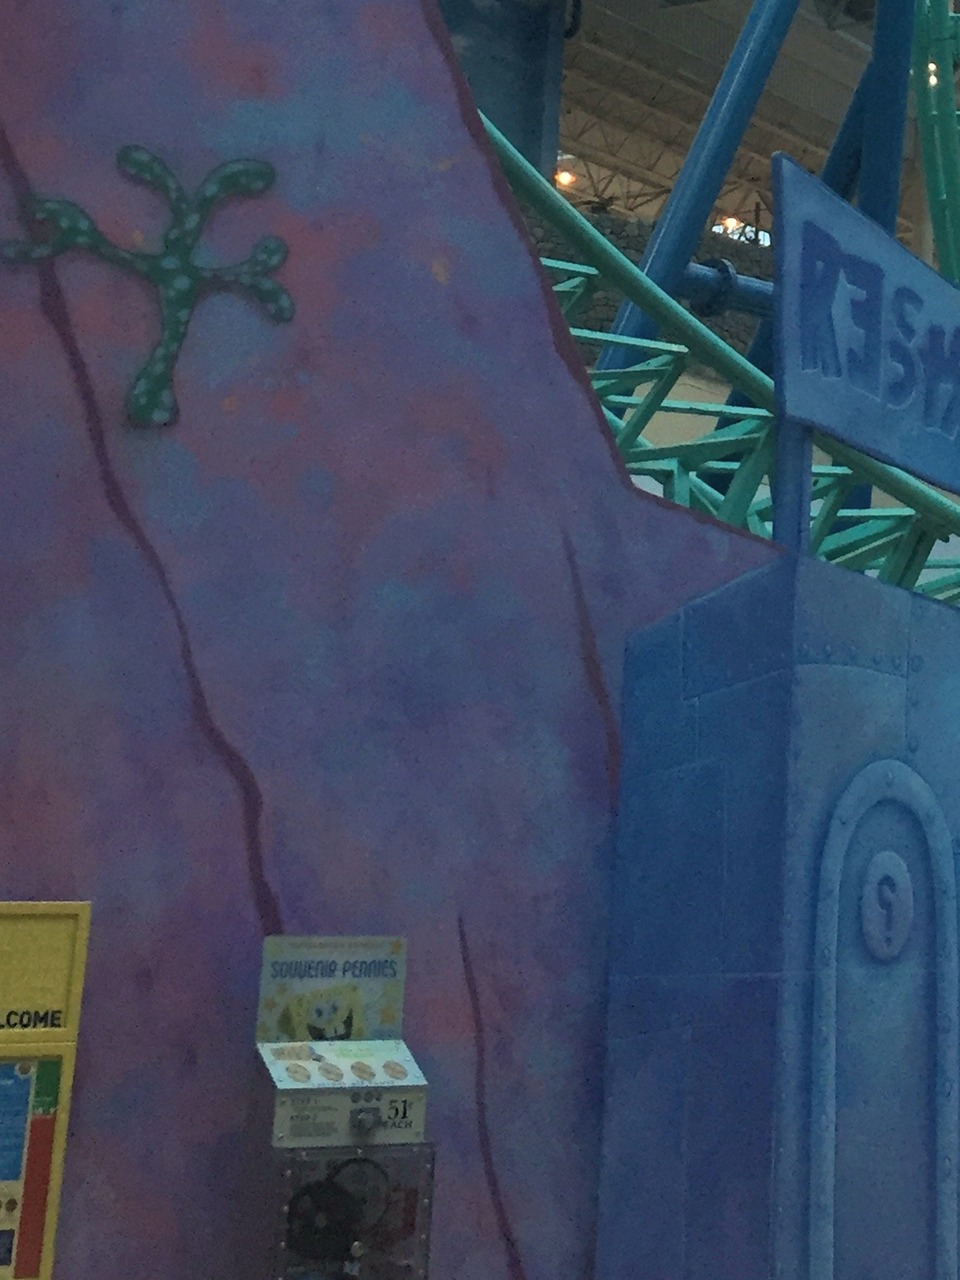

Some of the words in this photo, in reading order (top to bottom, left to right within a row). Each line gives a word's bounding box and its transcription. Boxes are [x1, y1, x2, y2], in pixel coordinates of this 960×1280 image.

[270, 959, 337, 979] SOUVENIR
[342, 959, 398, 979] PENNIES
[0, 1009, 62, 1030] COME
